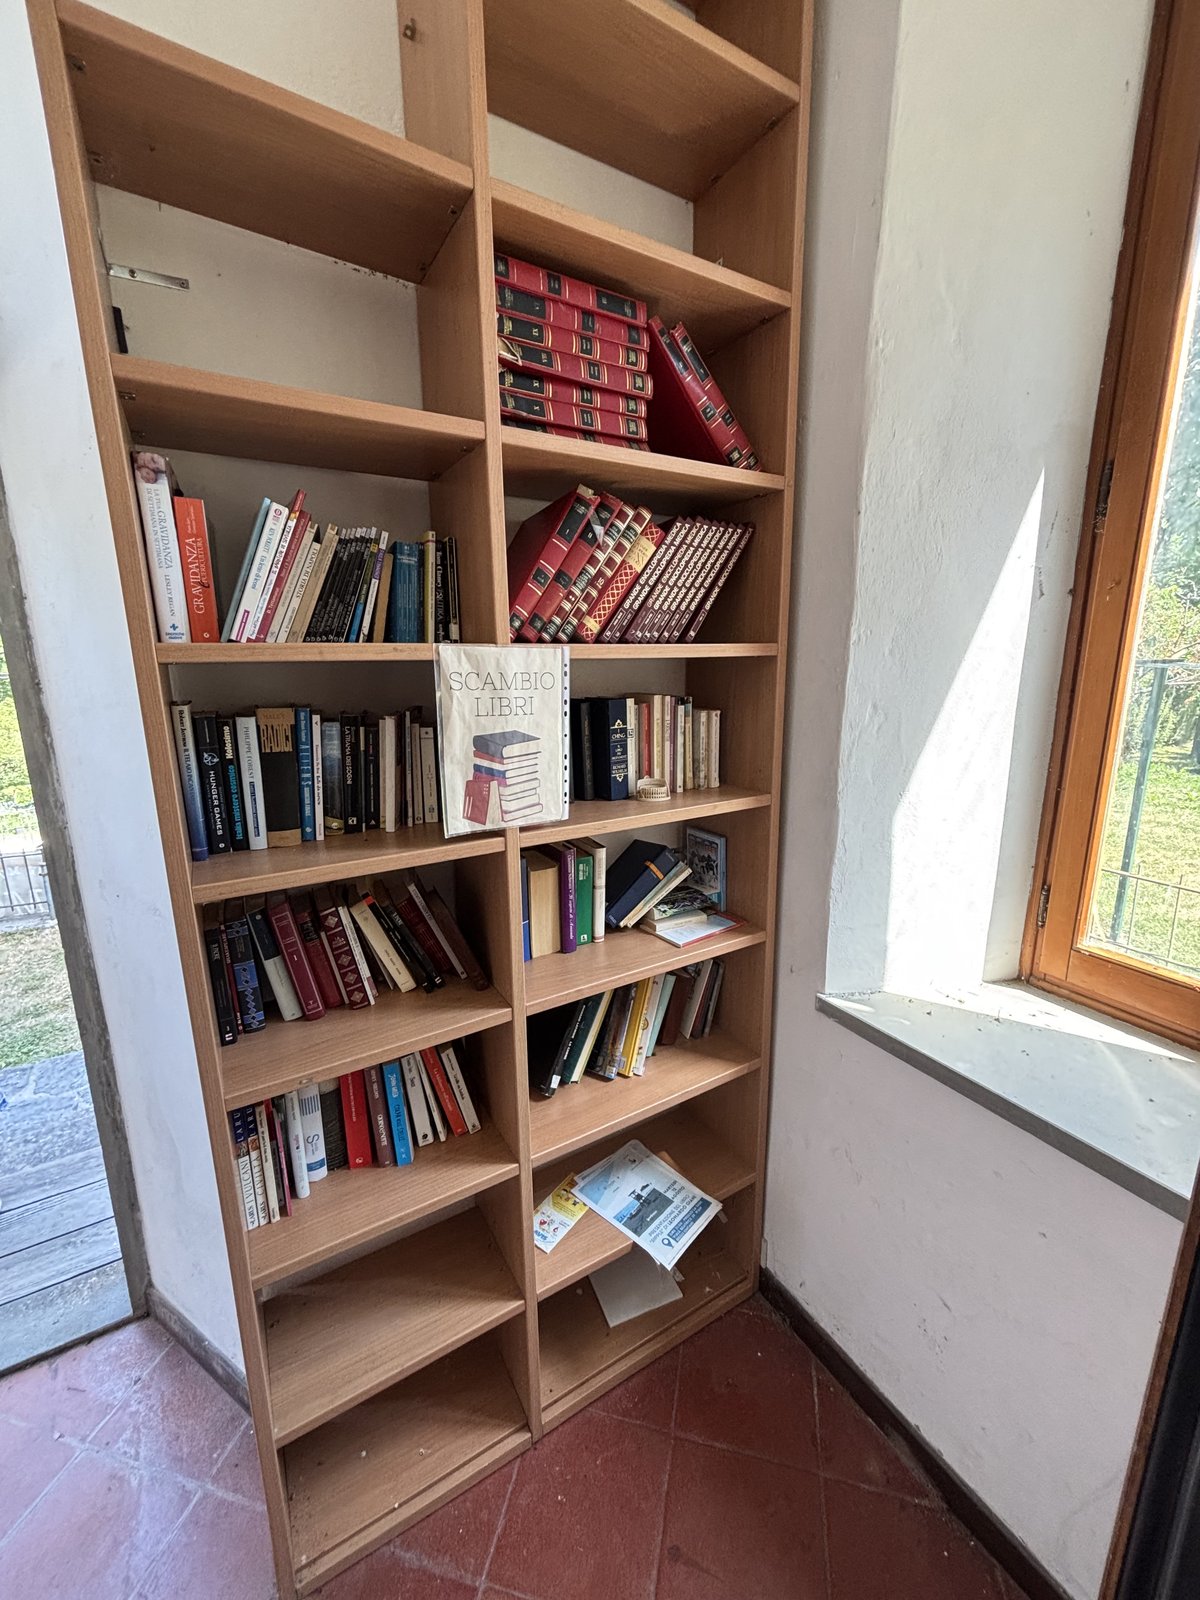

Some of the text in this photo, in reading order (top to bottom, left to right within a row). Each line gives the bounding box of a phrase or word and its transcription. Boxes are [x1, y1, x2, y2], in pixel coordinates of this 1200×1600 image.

[146, 487, 152, 495] DI
[147, 495, 157, 528] SETTIMANA
[153, 488, 159, 497] LA
[156, 509, 173, 569] GRAVIDANZA
[281, 524, 292, 544] SIVIGLIA
[153, 537, 163, 568] SETTIMANA
[196, 537, 207, 582] PUERICULTURA
[295, 547, 318, 598] STORIA DI NAPOLI
[622, 520, 682, 609] GRANDE ENCICLOPEDIA MEDICA
[631, 522, 690, 610] GRANDE ENCICLOPEDIA MEDICA
[645, 521, 701, 607] GRANDE ENCICLOPEDIA MEDICA
[652, 523, 708, 610] GRANDE ENCICLOPEDIA MEDICA
[661, 525, 717, 611] GRANDE ENCICLOPEDIA MEDICA
[670, 525, 724, 611] GRANDE ENCICLOPEDIA MEDICA
[679, 526, 733, 611] GRANDE ENCICLOPEDIA MEDICA
[688, 527, 742, 611] GRANDE ENCICLOPEDIA MEDICA
[703, 526, 754, 610] GRANDE ENCICLOPEDIA MEDICA
[163, 573, 176, 616] LESLEY REGAN
[184, 537, 205, 613] GRAVIDANZA
[449, 671, 555, 691] SCAMBIO
[177, 709, 186, 727] Robert
[474, 696, 534, 717] LIBRI
[222, 725, 233, 758] Kolosimo
[243, 726, 254, 778] PHILIPPE FOREST
[260, 723, 293, 753] RADICI
[299, 744, 311, 785] ALIENS
[209, 770, 223, 835] HUNGER GAMES
[227, 765, 243, 839] Italia mistero cosmico
[234, 1112, 243, 1141] LARU
[246, 1107, 255, 1136] LARU
[240, 1159, 252, 1199] VULCANI
[534, 1230, 548, 1241] AVIS
[648, 1208, 675, 1236] PRESENTAZIONE
[666, 1204, 687, 1225] LEONARDO
